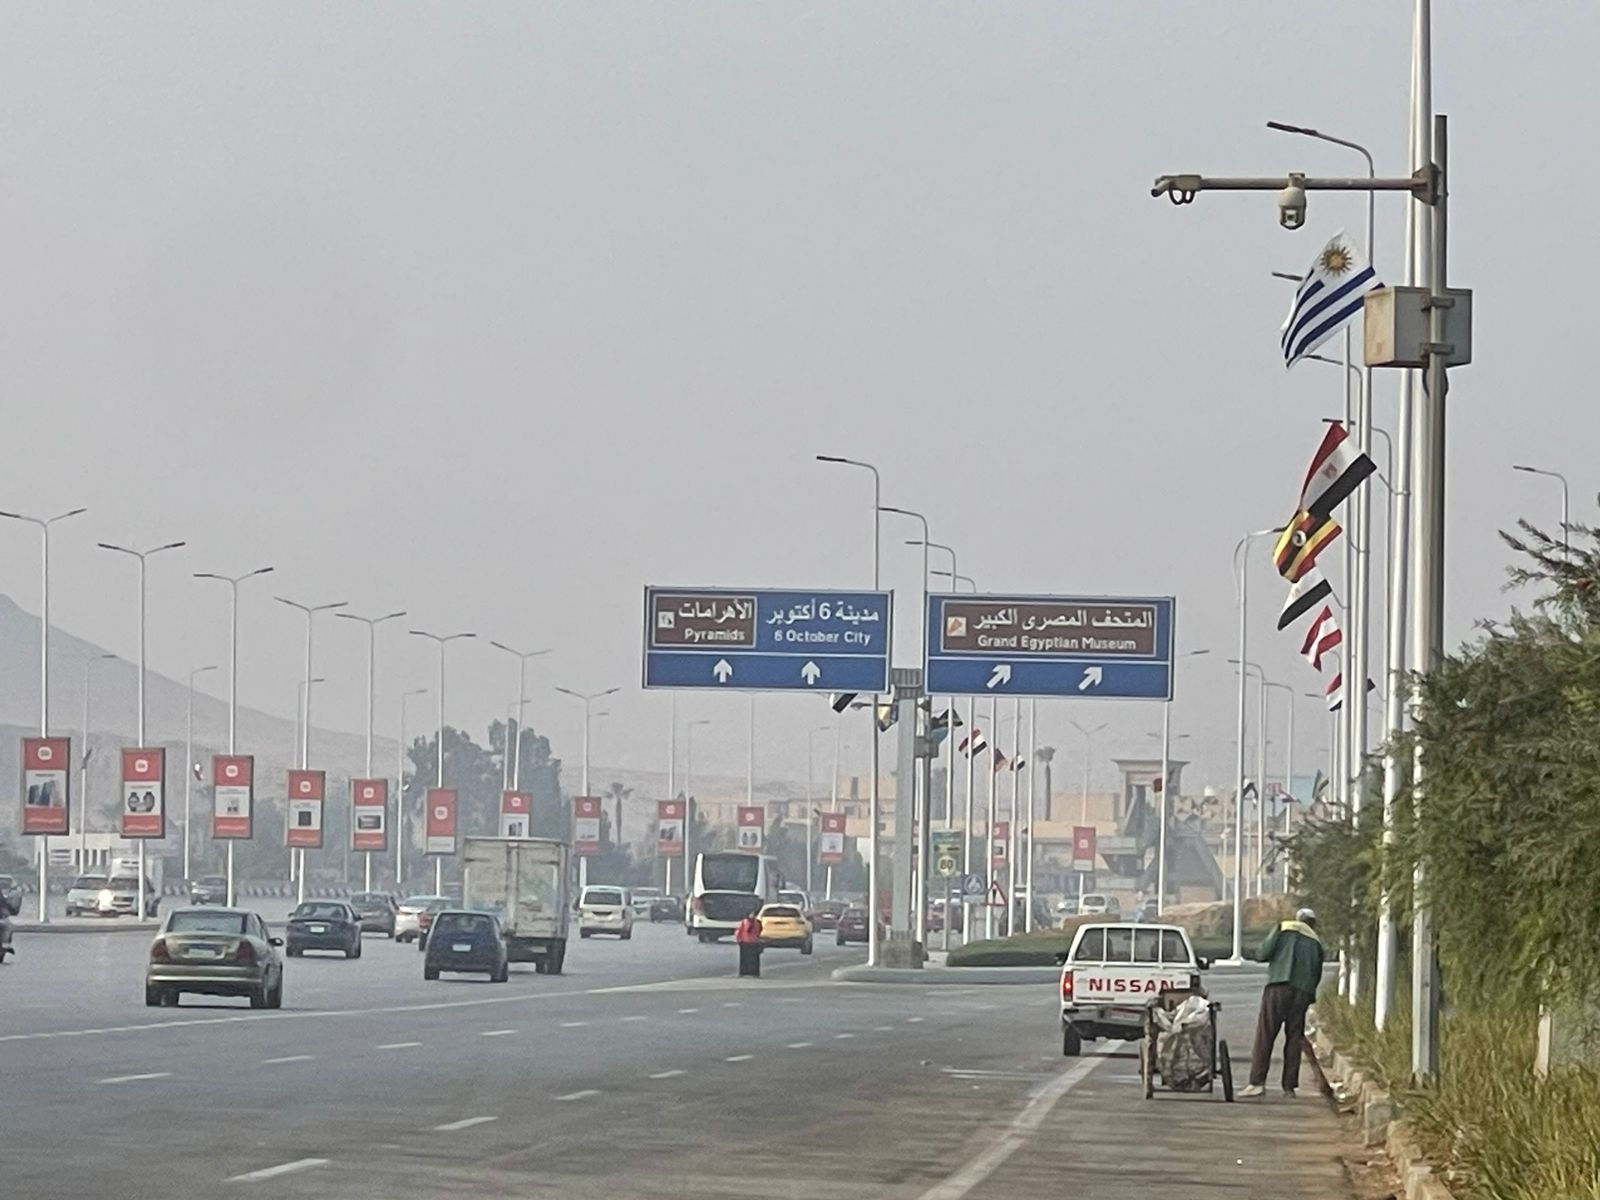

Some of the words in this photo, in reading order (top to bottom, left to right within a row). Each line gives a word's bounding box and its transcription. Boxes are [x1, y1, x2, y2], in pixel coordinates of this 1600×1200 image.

[679, 600, 752, 623] الأهرامات
[766, 598, 816, 625] أكتوبر
[819, 603, 830, 620] 6
[835, 602, 879, 624] مدينة
[973, 608, 1017, 629] الكبير
[1091, 611, 1152, 628] المتحف
[685, 628, 745, 642] Pyramids
[774, 631, 782, 641] 6
[786, 630, 839, 643] October
[844, 630, 871, 646] City
[978, 635, 1017, 647] Grand
[1021, 636, 1078, 651] Egyptian
[1082, 637, 1136, 650] Museum
[1089, 978, 1175, 993] NISSAN
